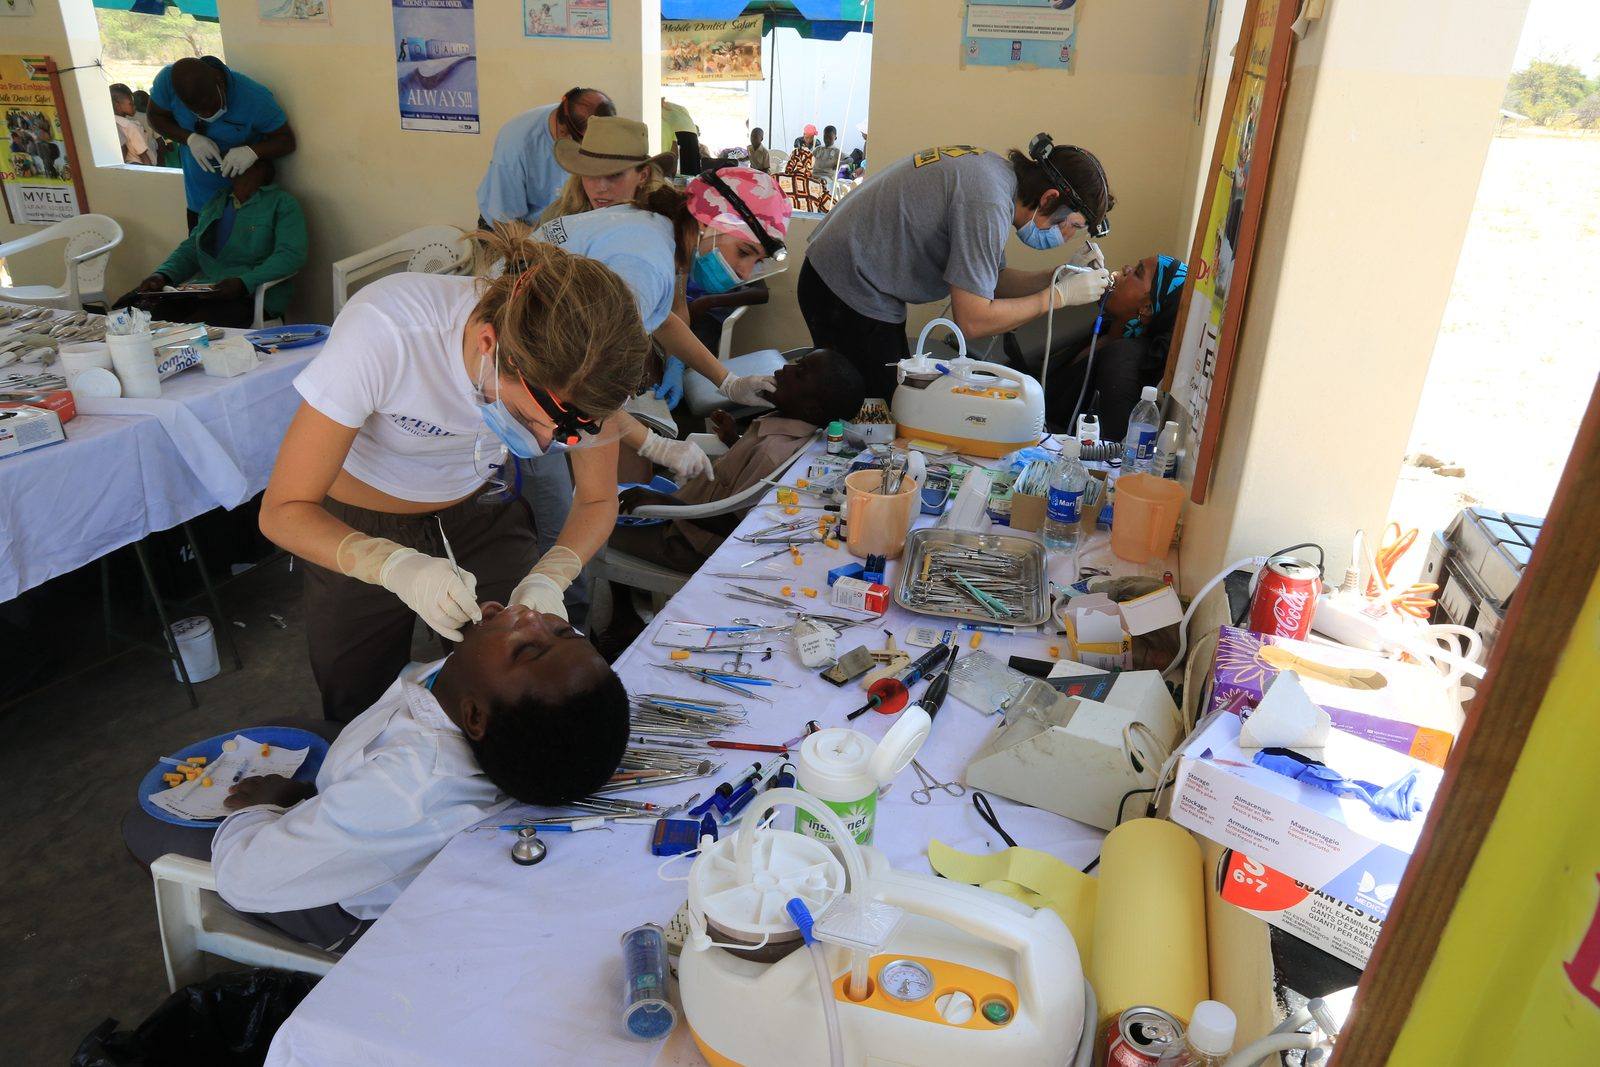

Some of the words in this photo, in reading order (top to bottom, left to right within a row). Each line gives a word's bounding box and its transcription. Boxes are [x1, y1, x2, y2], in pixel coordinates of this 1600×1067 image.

[662, 22, 690, 32] Mobile
[694, 21, 726, 32] Dentist
[731, 19, 757, 31] Safari
[407, 88, 472, 108] ALWAYS!!!
[1188, 772, 1210, 787] Storage
[1182, 794, 1208, 812] Stockage
[1234, 795, 1272, 816] Almacenaje
[1227, 818, 1280, 846] Armazenamento
[1290, 820, 1340, 846] Magazzinaggio
[1313, 899, 1334, 914] VINYL
[1308, 912, 1336, 930] GUANTI
[1336, 927, 1353, 938] PER
[1310, 906, 1336, 922] GANTS
[1336, 919, 1376, 943] D'EXAMEN
